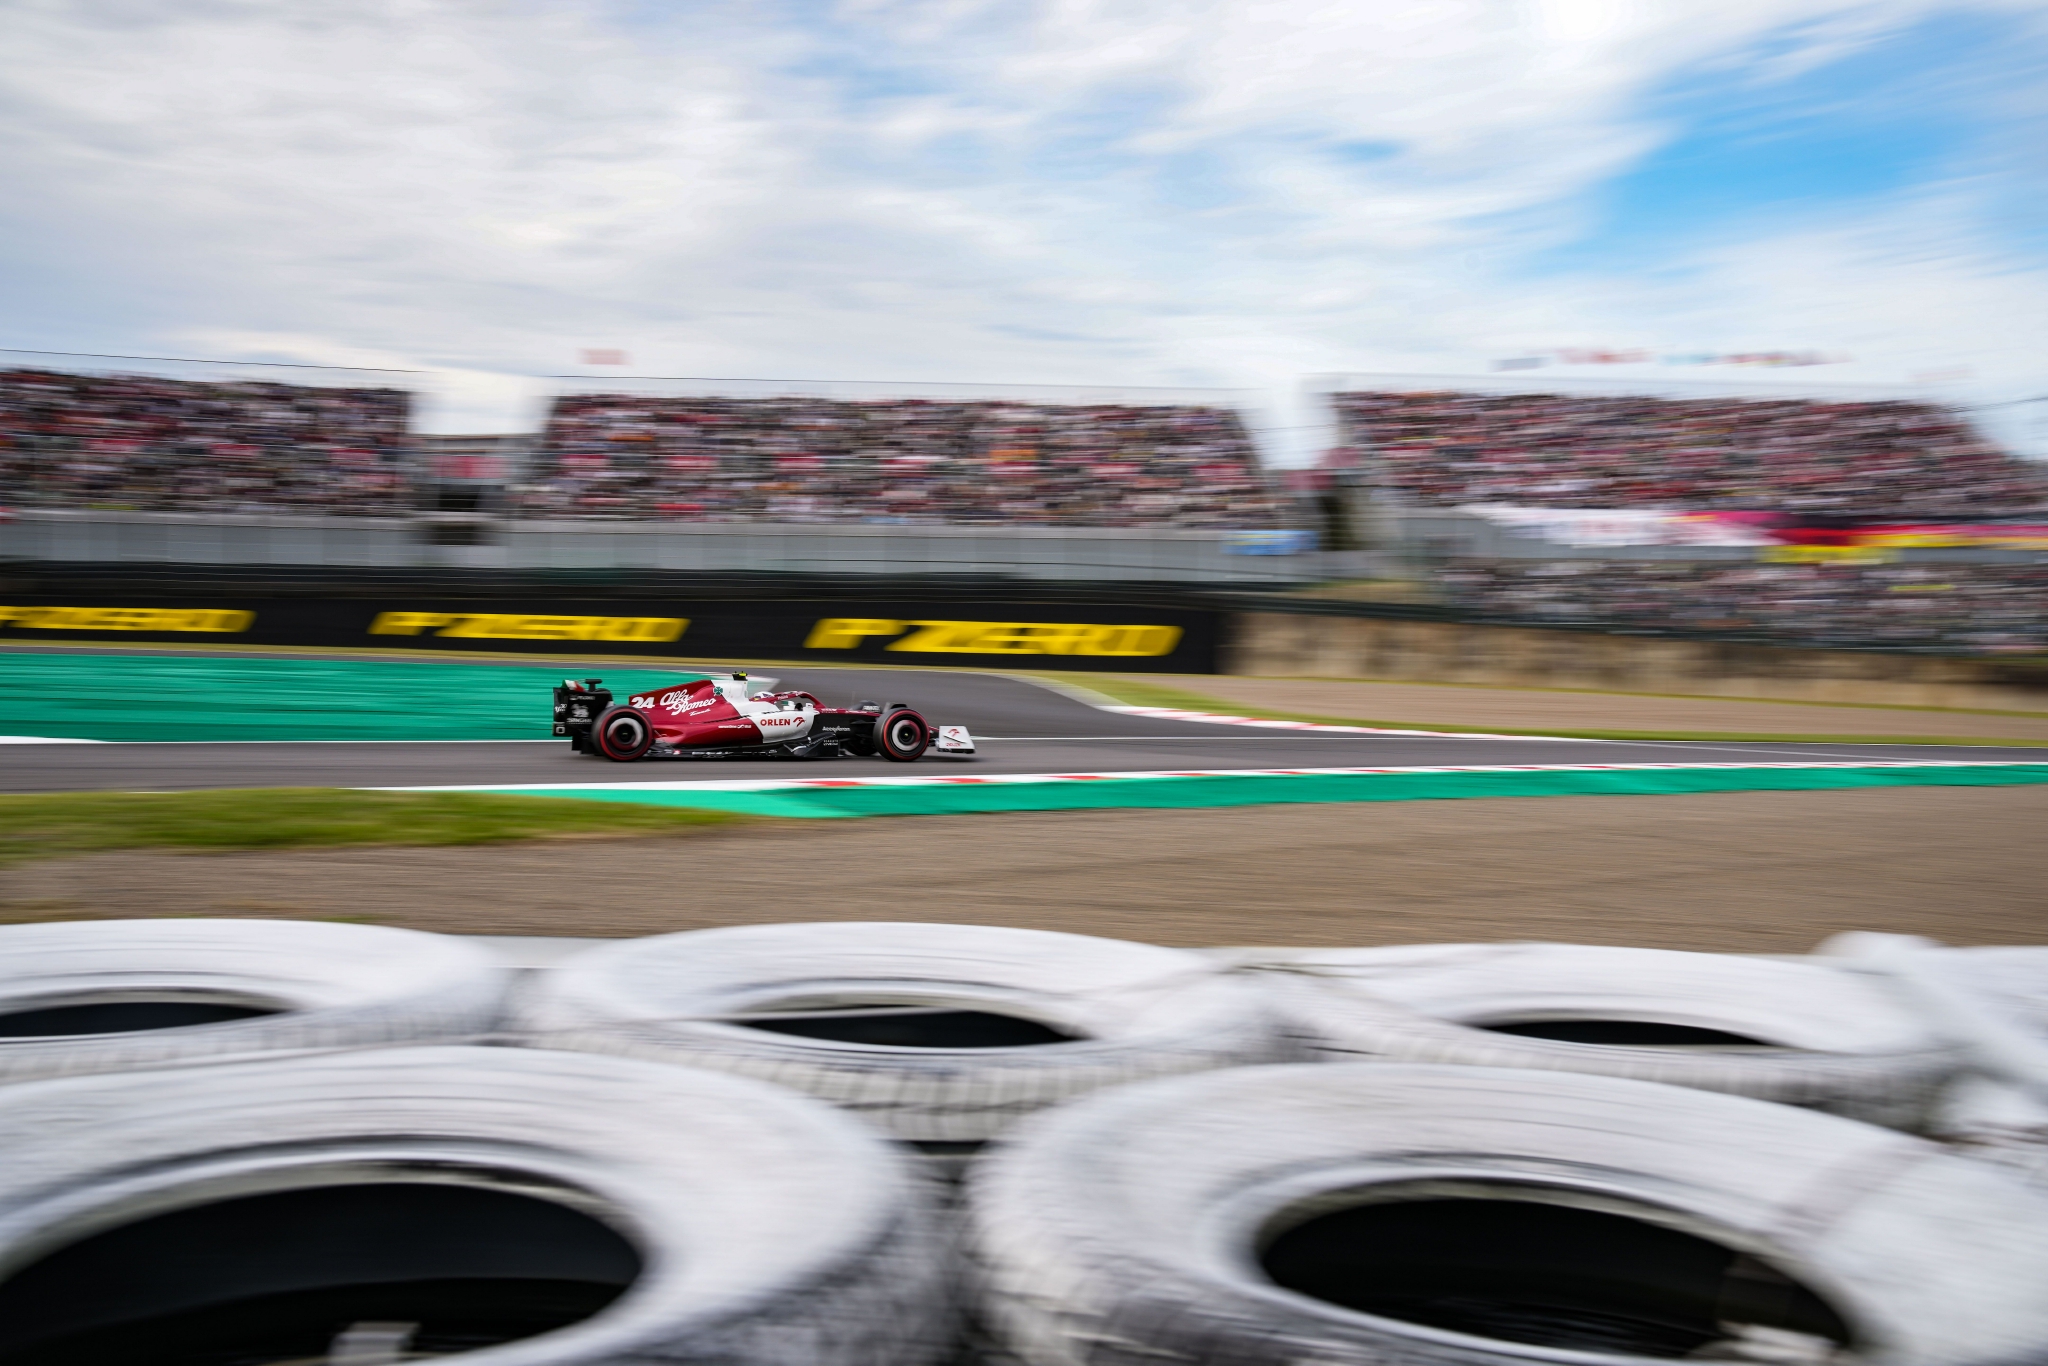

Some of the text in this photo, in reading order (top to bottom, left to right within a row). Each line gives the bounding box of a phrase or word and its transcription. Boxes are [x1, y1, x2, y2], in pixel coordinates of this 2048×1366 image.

[432, 613, 691, 642] ZERO
[803, 618, 1184, 656] P ZERO
[631, 696, 655, 709] 24
[660, 689, 694, 706] Alfa
[666, 698, 716, 716] Romeo
[760, 718, 791, 726] ORLEN
